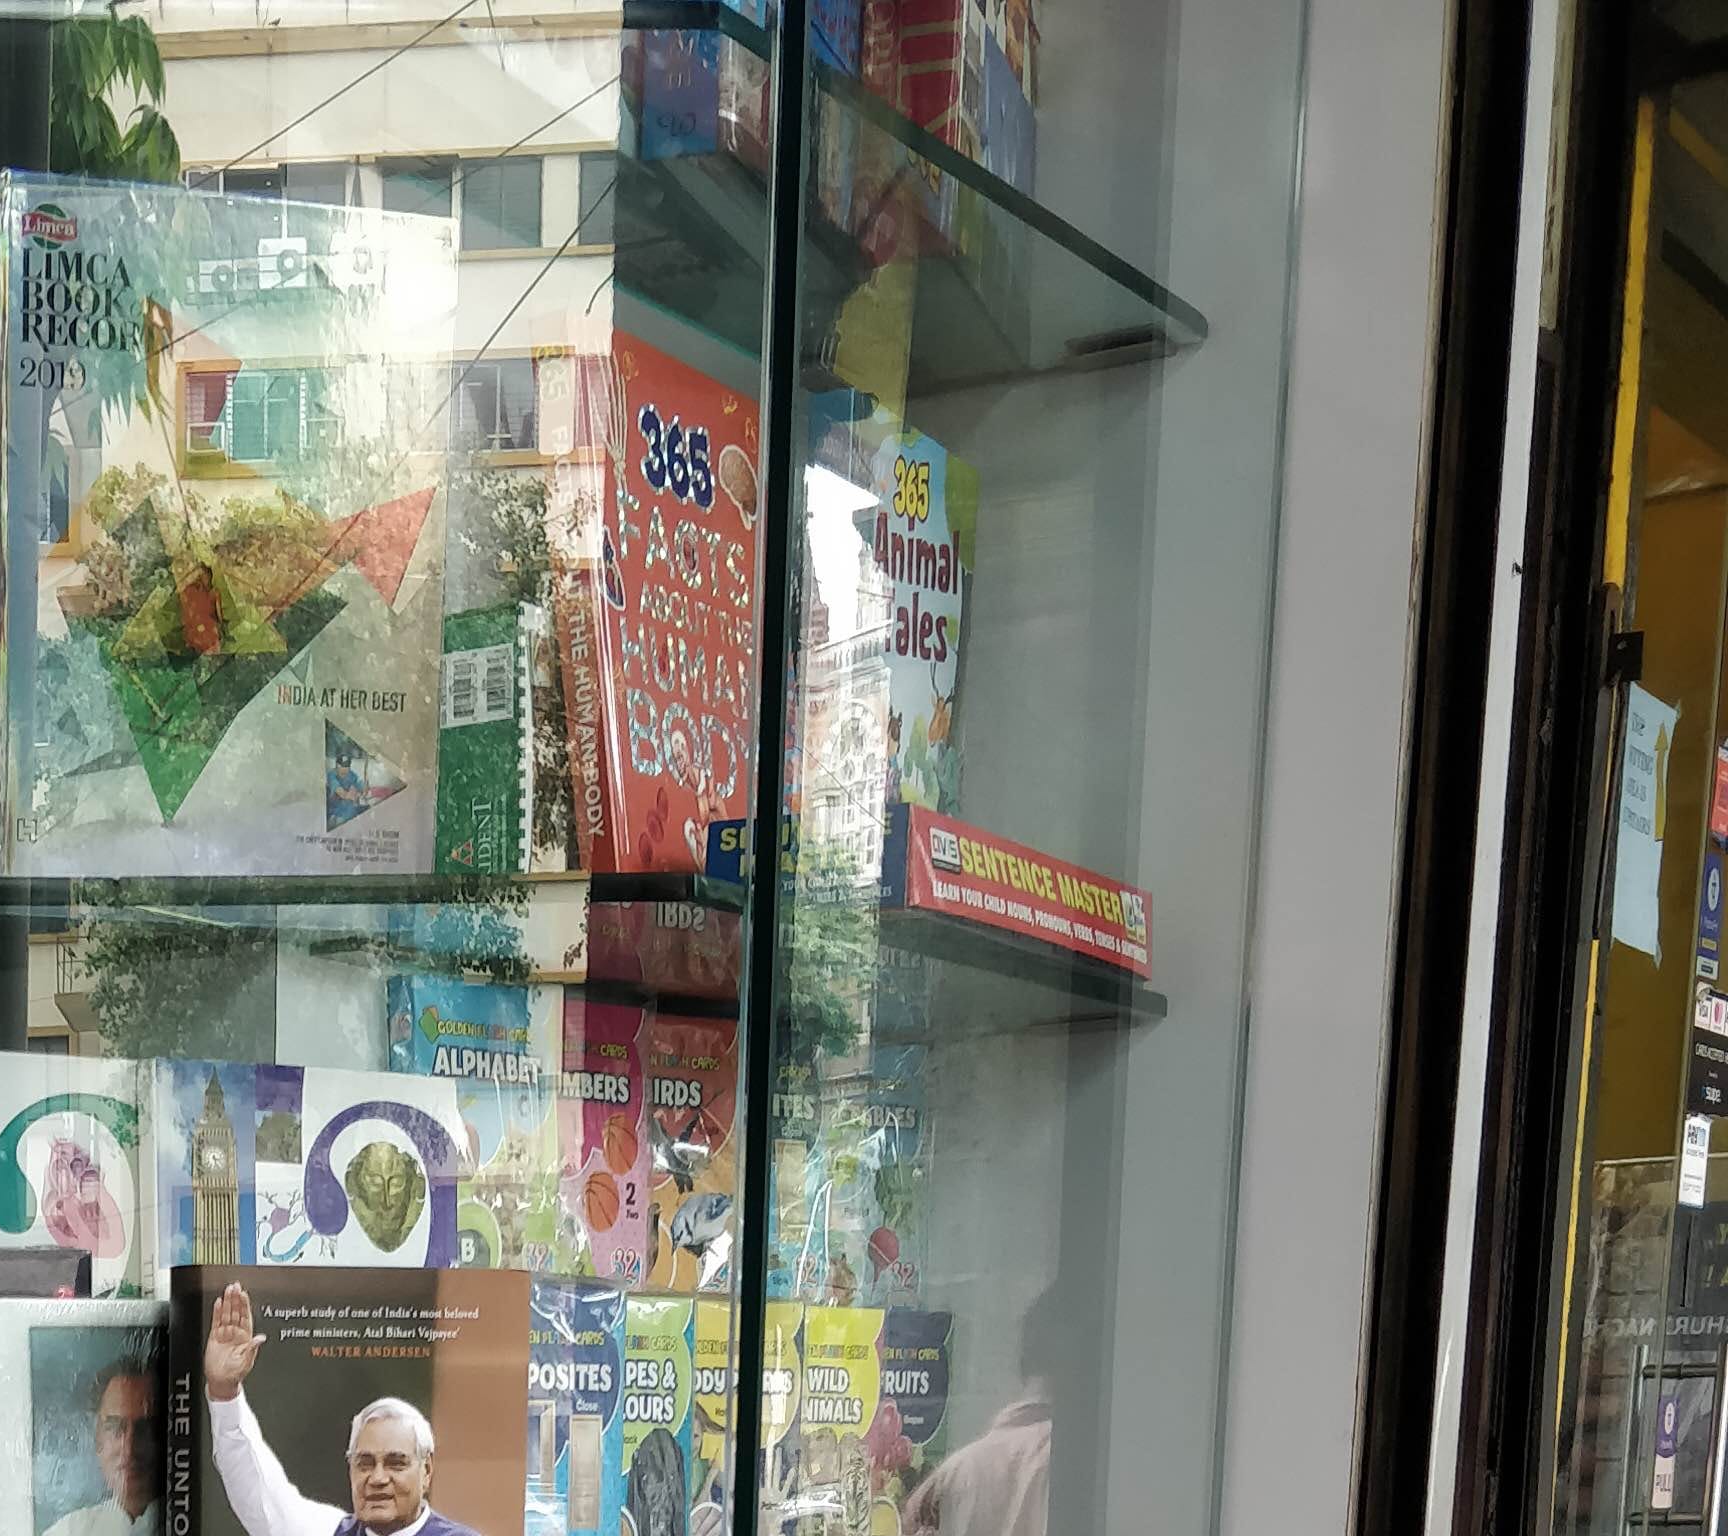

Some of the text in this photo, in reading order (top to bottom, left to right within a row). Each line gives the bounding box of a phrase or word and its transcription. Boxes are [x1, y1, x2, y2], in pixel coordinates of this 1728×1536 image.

[22, 248, 132, 288] LIMCA
[22, 281, 127, 316] BOOK
[20, 358, 86, 391] 2019
[639, 403, 715, 511] 365
[894, 455, 930, 524] 365
[874, 511, 960, 597] Animal
[960, 836, 1125, 924] SENTENCE MASTER
[433, 1047, 542, 1083] ALPHABET
[807, 1366, 848, 1393] WILD
